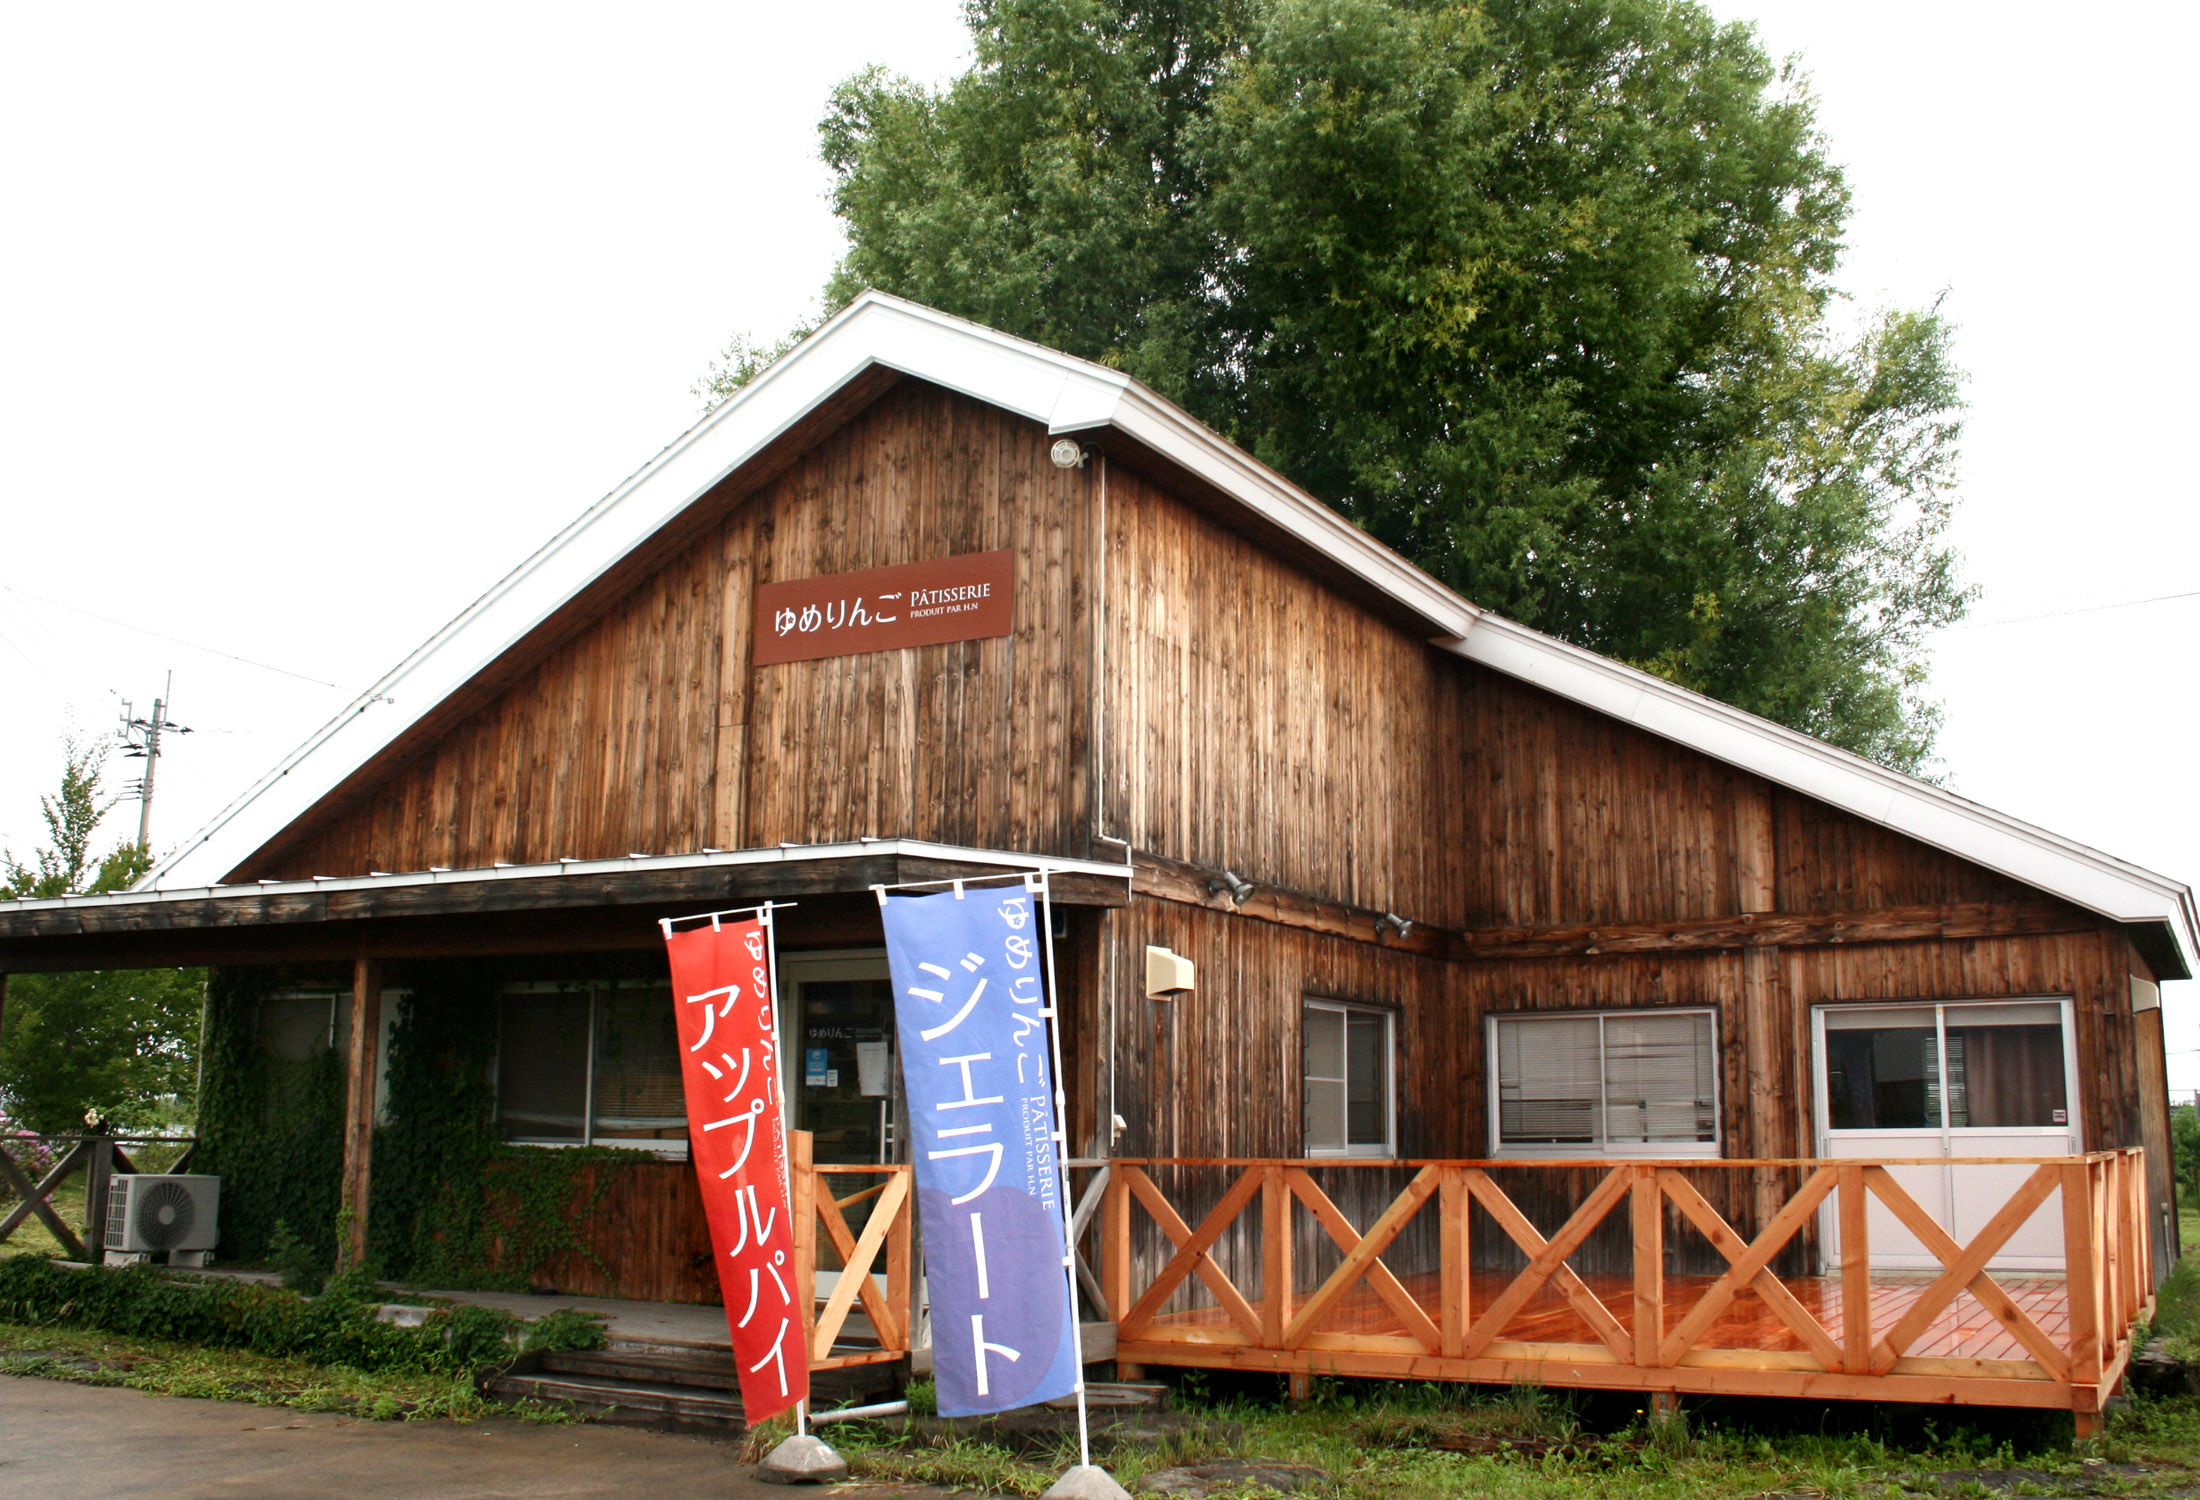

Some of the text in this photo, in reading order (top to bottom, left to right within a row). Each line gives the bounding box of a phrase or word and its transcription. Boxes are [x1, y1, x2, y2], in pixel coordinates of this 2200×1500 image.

[775, 592, 902, 637] ゆめりんご
[910, 606, 945, 619] PRODUIT
[946, 604, 962, 614] PAR
[911, 583, 991, 607] PÂTISSERIE
[997, 898, 1046, 1087] ゆめりんご
[1021, 1097, 1033, 1147] PRODUIT
[1025, 1151, 1035, 1172] PAR
[1030, 1095, 1055, 1211] PÂTISSERIE
